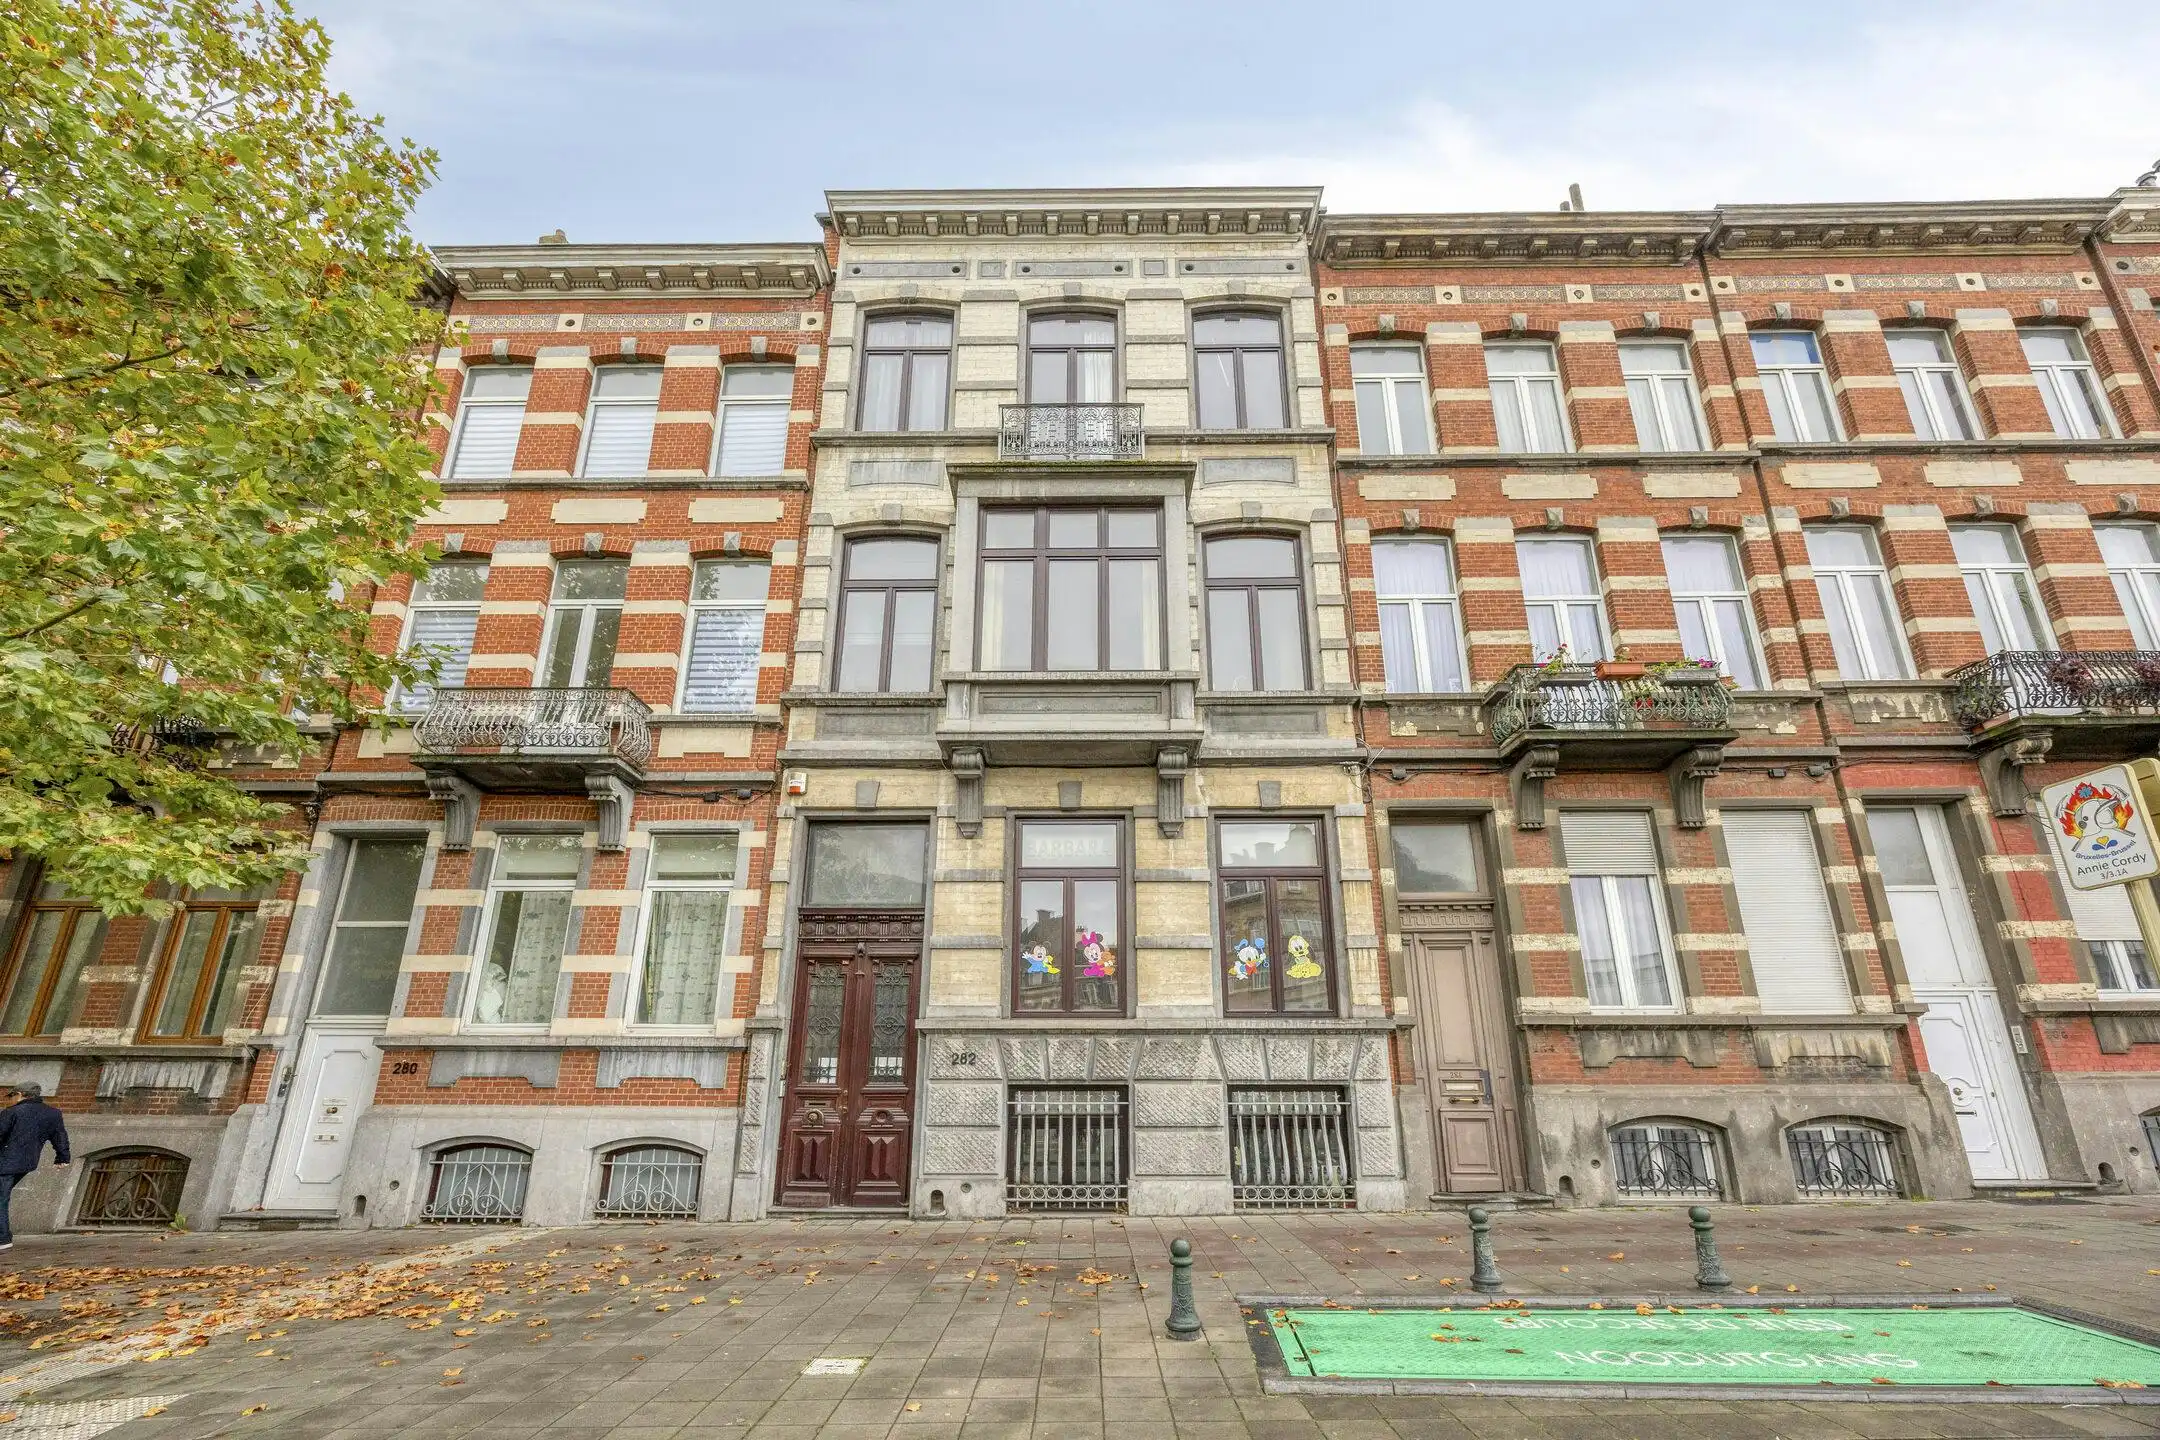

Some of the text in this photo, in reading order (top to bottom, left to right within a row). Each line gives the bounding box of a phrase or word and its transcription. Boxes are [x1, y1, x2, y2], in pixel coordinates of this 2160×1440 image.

[2075, 840, 2136, 860] Bruxelles-Brussel
[2077, 853, 2147, 876] Annie Cordy
[951, 1052, 976, 1066] 282
[392, 1062, 418, 1075] 280
[1493, 1317, 1677, 1331] SECOURS
[1746, 1318, 1854, 1332] ISSUE
[1551, 1350, 1919, 1369] NOODUITGANG
